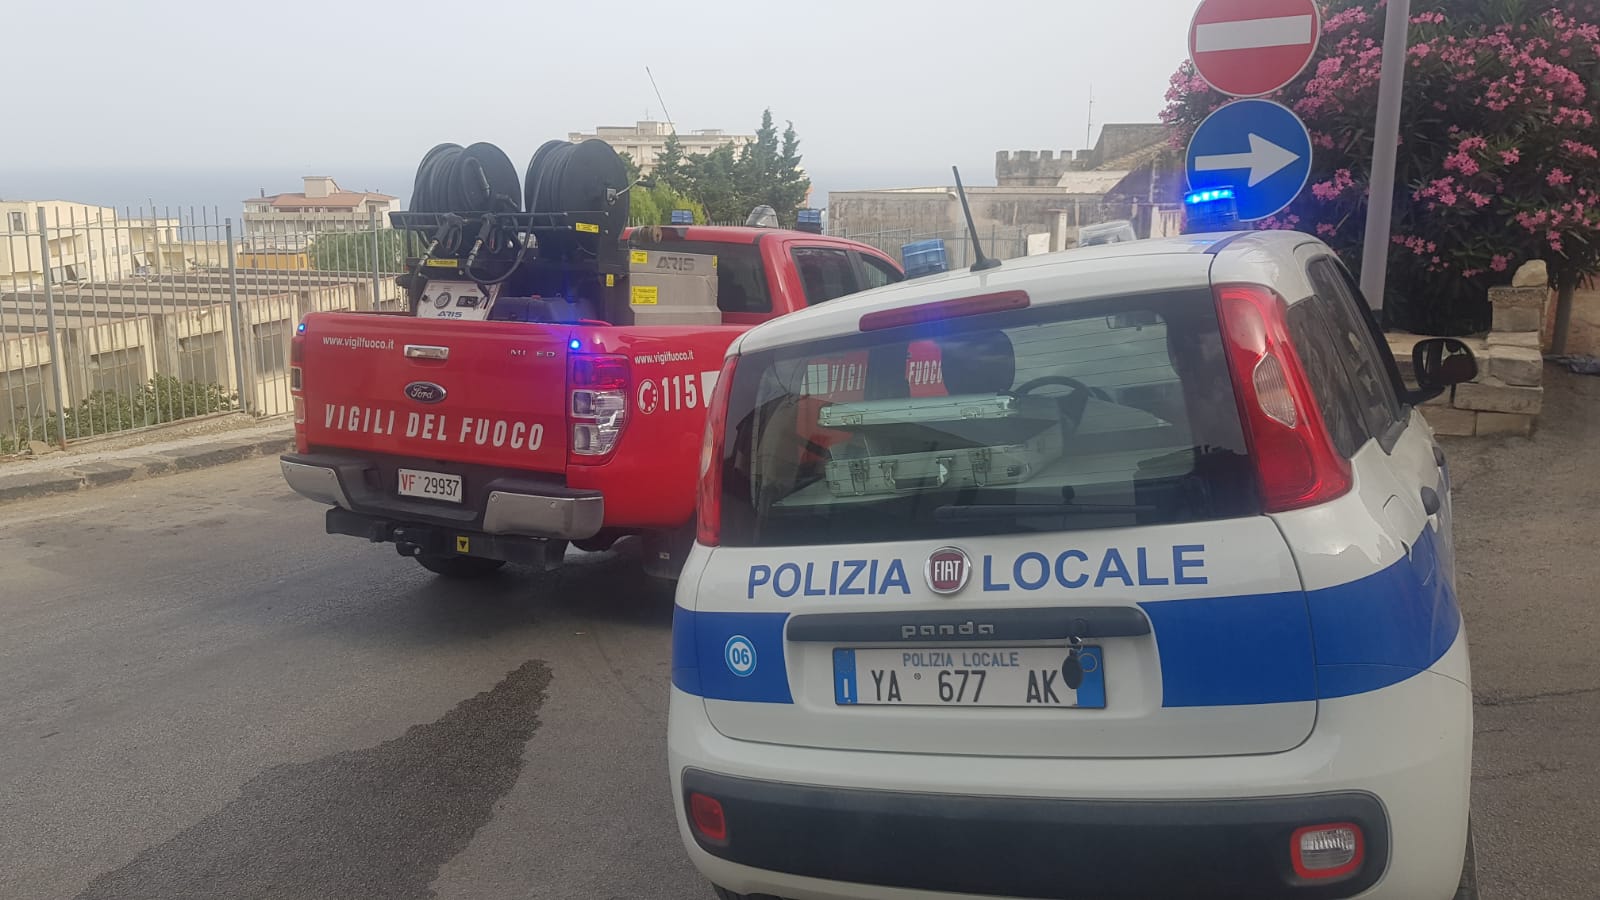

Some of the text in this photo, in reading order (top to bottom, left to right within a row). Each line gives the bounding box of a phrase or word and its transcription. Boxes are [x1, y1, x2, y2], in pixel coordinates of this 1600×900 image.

[656, 256, 695, 271] ARIS
[322, 335, 395, 350] www.vigilfuoco.it
[634, 349, 694, 365] www.vigilfuoco.it
[831, 363, 868, 393] VIGI
[410, 384, 434, 400] Ford
[661, 374, 698, 412] 115
[324, 403, 545, 451] VIGILI DEL FUOCO
[400, 473, 461, 497] VF 29937
[747, 544, 1209, 600] POLIZIA LOCALE
[933, 560, 962, 582] FIAT
[901, 621, 995, 640] panda
[731, 647, 751, 666] 06
[902, 651, 1020, 668] POLIZIA LOCALE
[870, 669, 903, 702] YA
[937, 669, 988, 703] 677
[1025, 669, 1061, 704] AK
